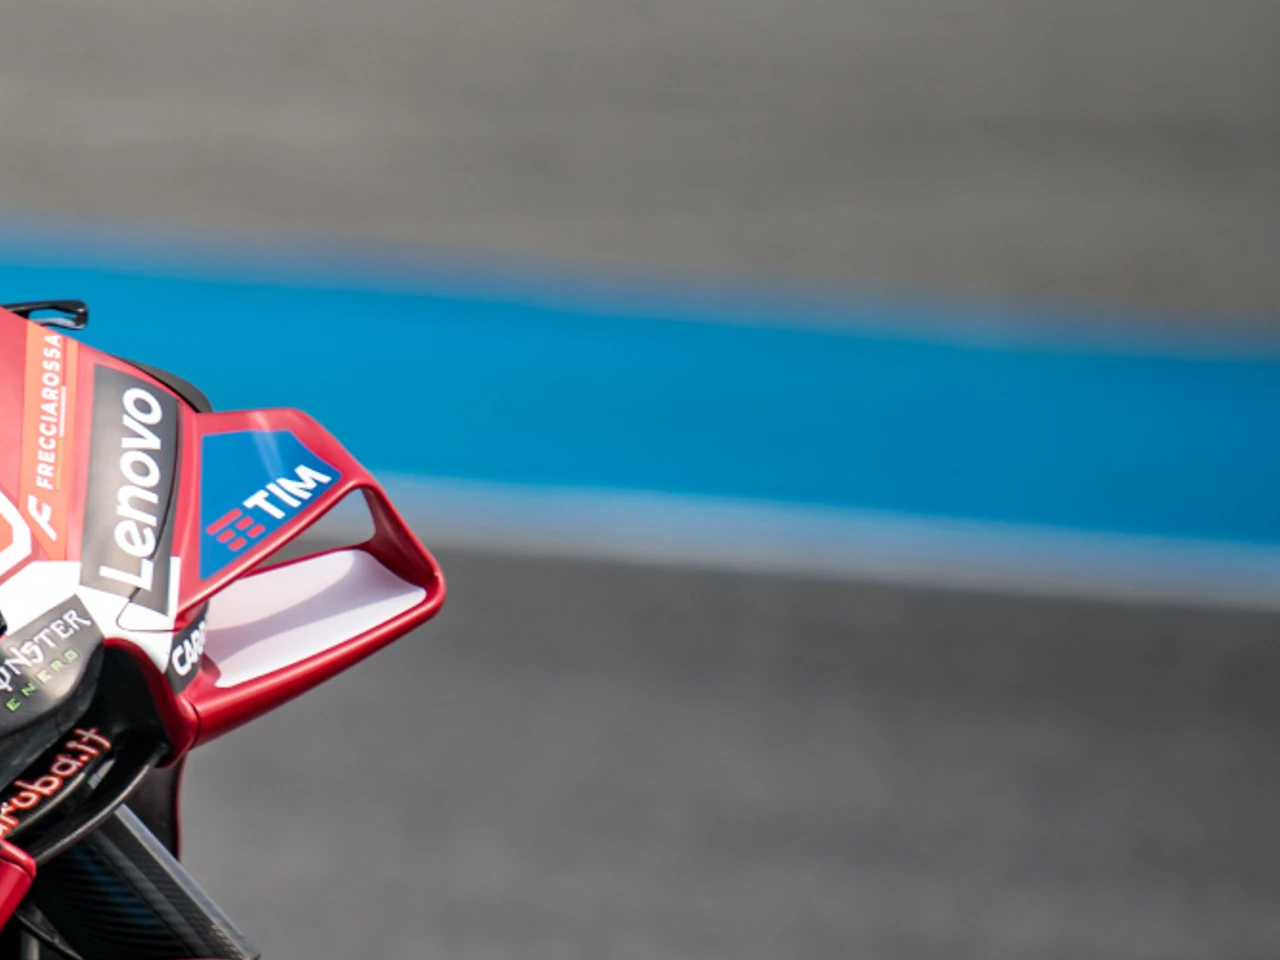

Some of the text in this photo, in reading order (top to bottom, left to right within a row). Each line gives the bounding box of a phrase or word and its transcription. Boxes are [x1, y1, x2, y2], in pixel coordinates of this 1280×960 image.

[36, 334, 61, 490] FRECCIAROSSA
[100, 386, 163, 592] Lenovo
[243, 463, 332, 520] TIM
[6, 649, 79, 711] ENERG
